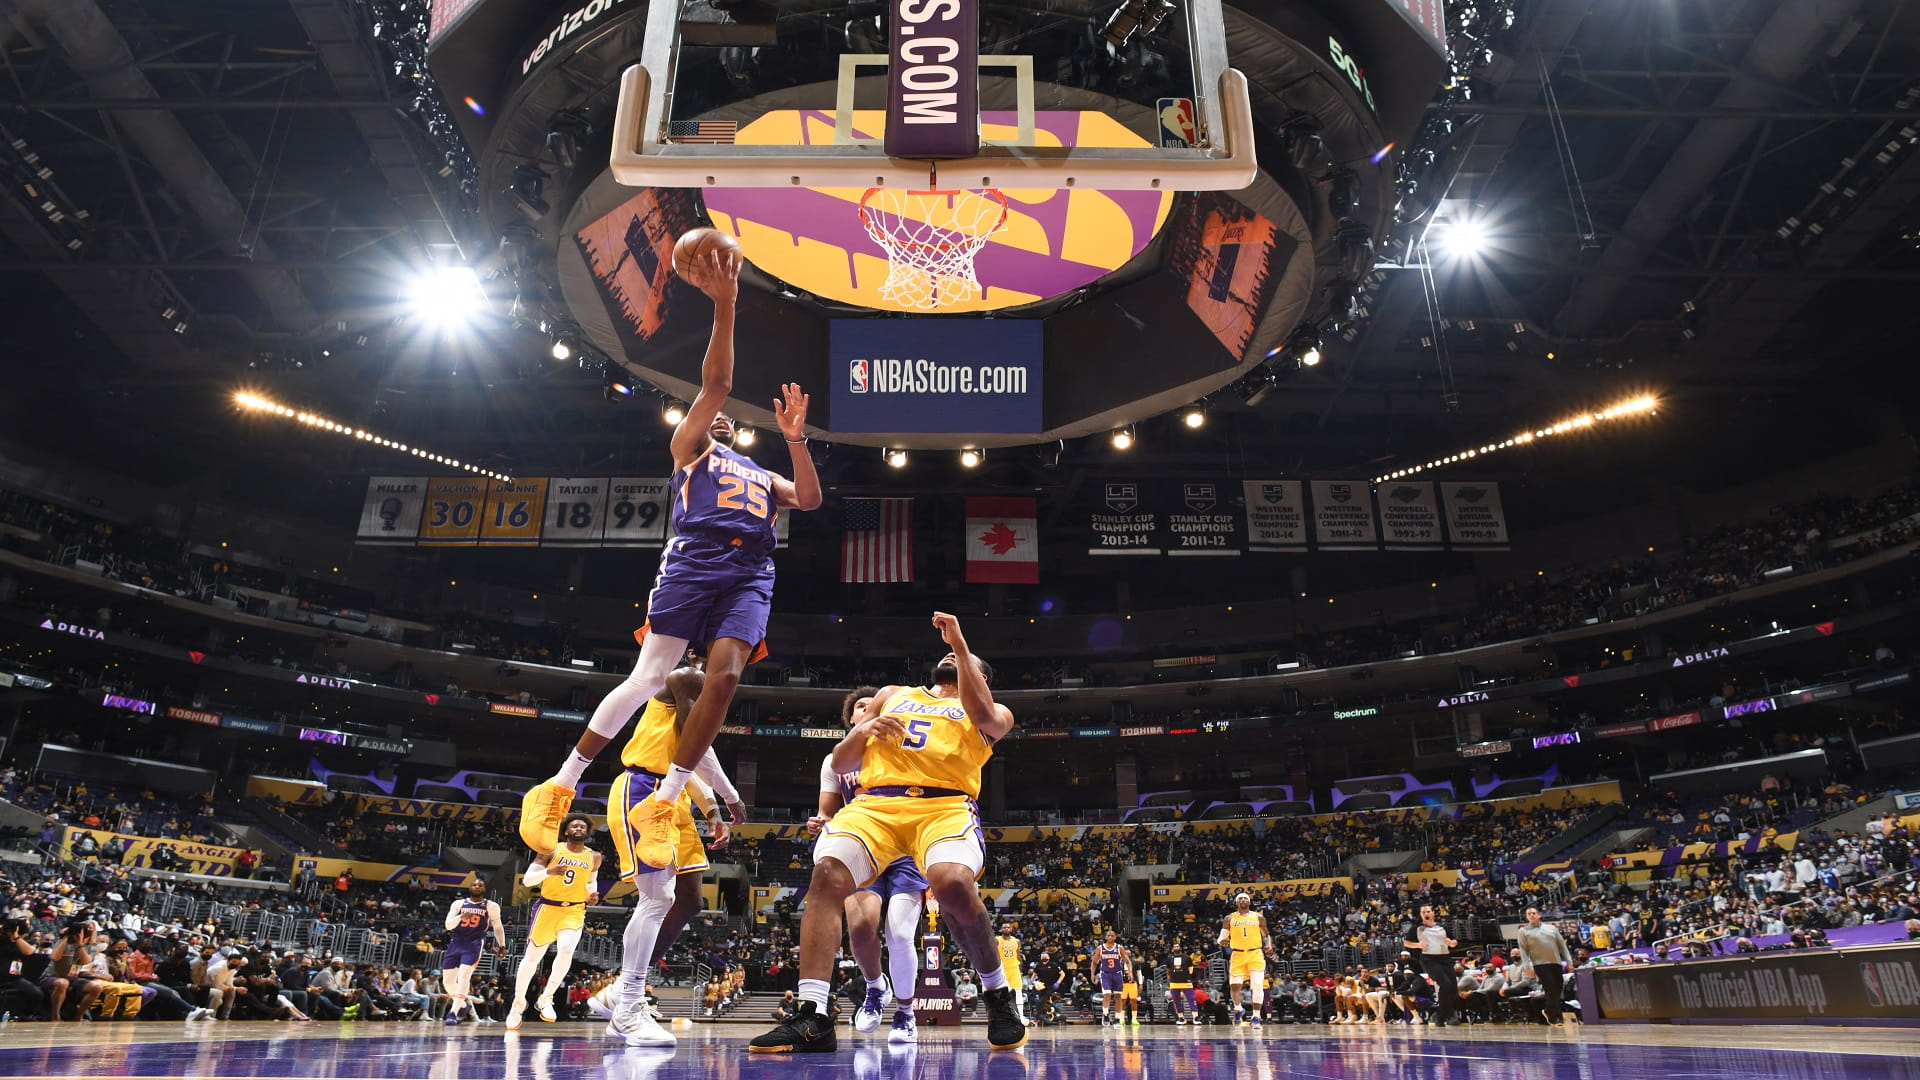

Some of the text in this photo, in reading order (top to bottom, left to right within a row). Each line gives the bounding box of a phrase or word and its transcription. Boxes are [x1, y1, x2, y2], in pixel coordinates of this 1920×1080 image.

[873, 359, 1027, 393] NBAStore.com
[376, 484, 417, 494] MILLER
[558, 485, 598, 495] TAYLOR
[614, 484, 664, 495] GRETZKY
[717, 475, 768, 519] 25
[430, 501, 475, 528] 30
[495, 501, 530, 528] 16
[556, 502, 592, 528] 18
[613, 502, 660, 529] 99
[1091, 514, 1154, 523] STANLEY CUP
[1170, 515, 1233, 524] STANLEY CUP
[1250, 513, 1300, 521] CONFERENCE
[1092, 522, 1156, 532] CHAMPIONS
[1170, 523, 1234, 533] CHAMPIONS
[1254, 521, 1299, 529] CHAMPIONS
[1100, 534, 1148, 545] 2013-14
[1260, 530, 1294, 539] 2013-14
[1330, 529, 1363, 538] 2011-12
[1181, 535, 1227, 547] 2011-12
[57, 622, 105, 640] DELTA
[1685, 648, 1729, 664] DELTA
[310, 675, 351, 689] DELTA
[1451, 692, 1489, 705] DELTA
[169, 707, 220, 724] TOSHIBA
[889, 699, 965, 720] LAKERS
[1333, 707, 1377, 719] Spectrum
[247, 723, 269, 731] LIGHT
[766, 728, 798, 736] DELTA
[803, 728, 844, 738] STAPLES
[1121, 727, 1164, 736] TOSHIBA
[901, 719, 932, 751] 5
[371, 741, 405, 753] DELTA
[1465, 741, 1510, 757] STAPLES
[558, 856, 591, 870] LAKERS
[563, 869, 576, 885] 9
[460, 914, 481, 928] 99
[1243, 927, 1247, 937] 1
[1003, 950, 1014, 958] 23
[1108, 959, 1115, 968] 3
[1875, 961, 1920, 1007] NBA
[1673, 967, 1828, 1014] The Official NBA App
[1609, 978, 1652, 1016] NBA App
[919, 998, 954, 1011] PLAYOFFS
